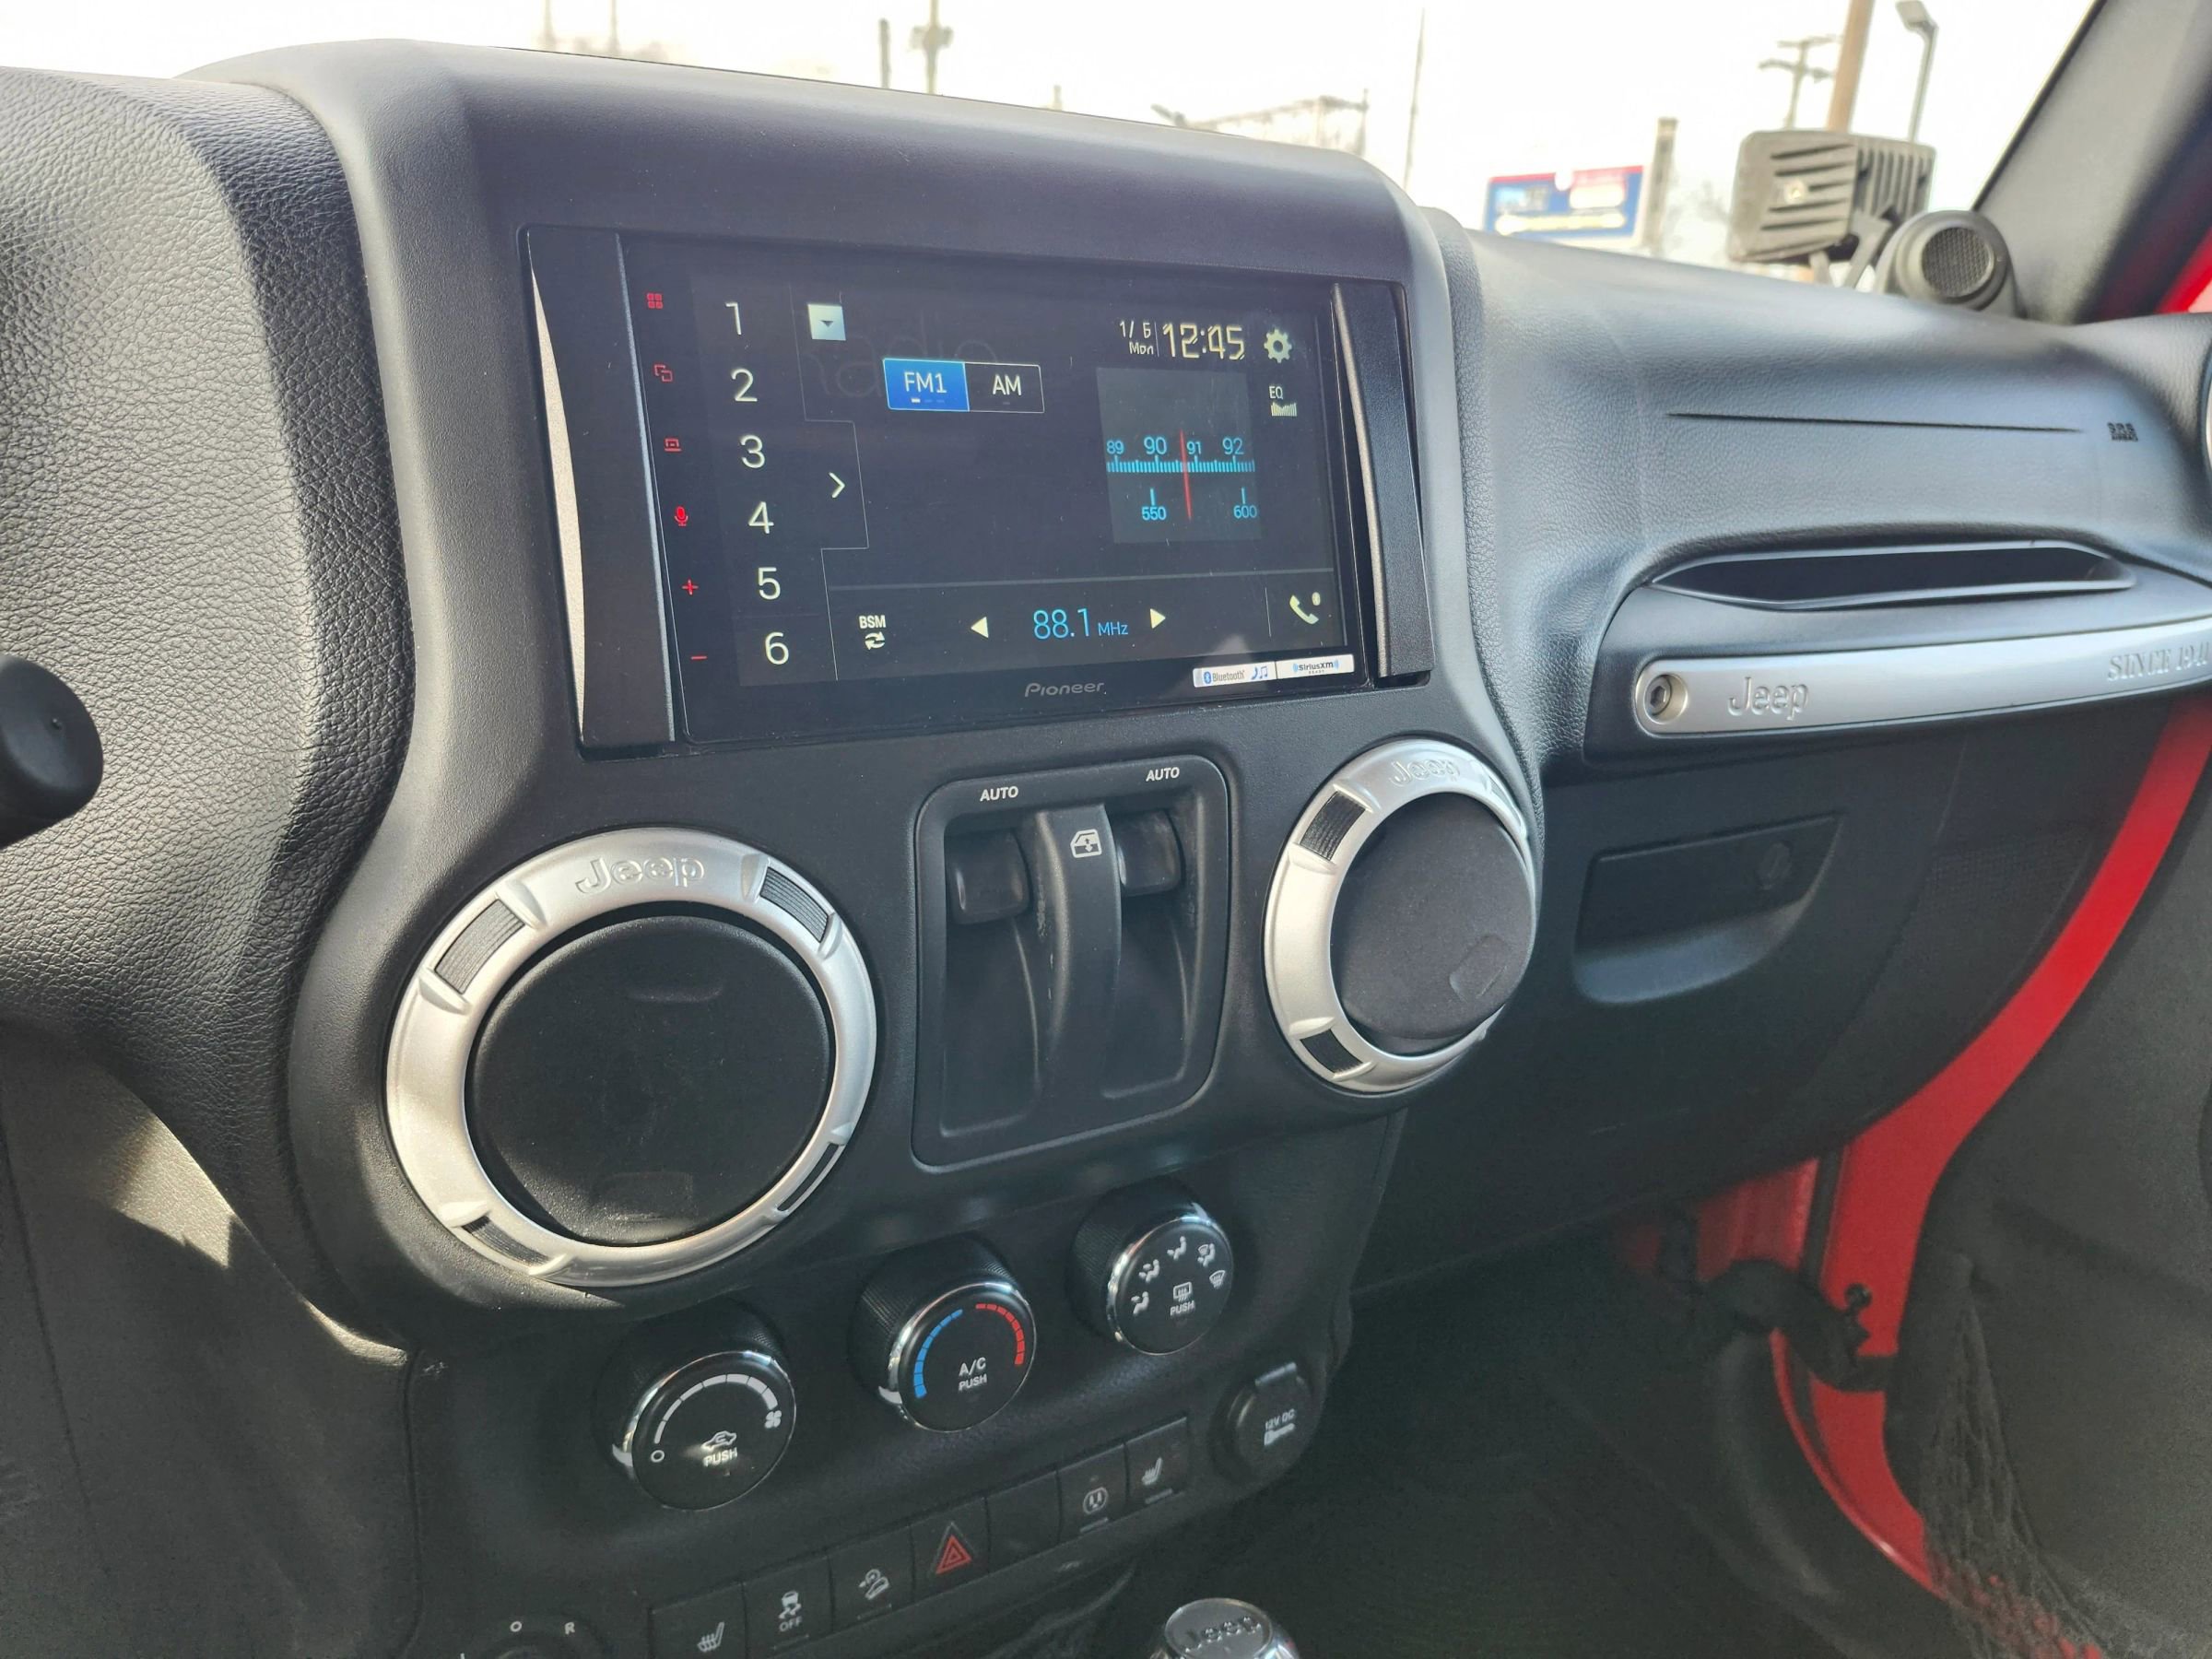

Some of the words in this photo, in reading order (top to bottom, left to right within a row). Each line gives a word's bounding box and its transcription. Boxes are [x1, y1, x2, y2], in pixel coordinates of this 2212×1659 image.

[724, 301, 742, 335] 1
[1129, 341, 1154, 355] Mon
[1161, 323, 1246, 360] 12:45
[731, 369, 758, 402] 2
[903, 371, 947, 394] FM1
[992, 374, 1022, 396] AM
[1268, 385, 1284, 400] EQ
[740, 434, 766, 468] 3
[1106, 439, 1124, 455] 89
[1143, 436, 1167, 455] 90
[1186, 441, 1202, 455] 91
[1222, 437, 1244, 455] 92
[748, 501, 774, 534] 4
[1141, 506, 1167, 521] 550
[1233, 505, 1257, 519] 600
[758, 567, 782, 600] 5
[858, 614, 887, 629] BSM
[1032, 607, 1090, 640] 88.1
[1098, 621, 1129, 636] MHz
[764, 632, 789, 665] 6
[2107, 648, 2171, 682] SINCE
[1211, 670, 1245, 682] Bluetooth
[1024, 681, 1105, 698] Pioneer
[1727, 676, 1809, 722] Jeep
[1145, 766, 1181, 782] AUTO
[1389, 759, 1461, 787] Jeep
[979, 785, 1019, 802] AUTO
[574, 856, 705, 895] Jeep
[1170, 1300, 1195, 1317] PUSH
[959, 1357, 987, 1377] A/C
[958, 1373, 988, 1392] PUSH
[703, 1447, 738, 1467] PUSH
[564, 1621, 576, 1635] R
[779, 1615, 803, 1631] OFF
